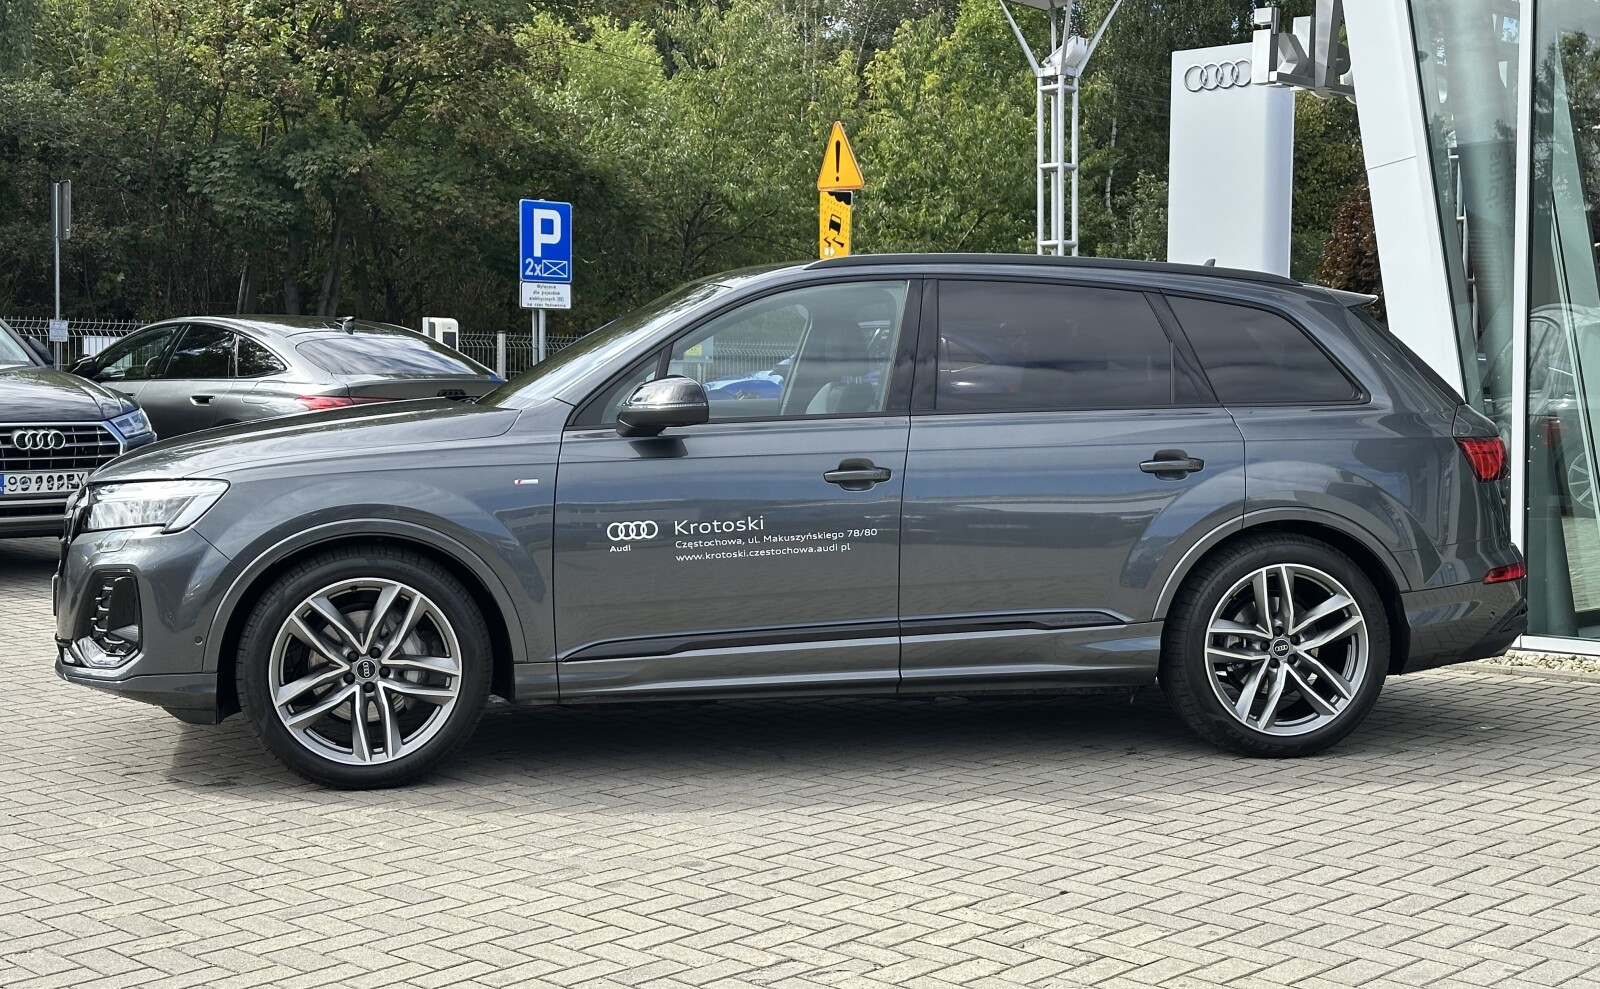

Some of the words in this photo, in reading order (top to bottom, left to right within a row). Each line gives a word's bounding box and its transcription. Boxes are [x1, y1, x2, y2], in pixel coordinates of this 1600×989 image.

[533, 208, 562, 258] P
[524, 258, 542, 276] 2x
[674, 515, 764, 536] Krotoski
[609, 544, 631, 553] Audi
[675, 537, 745, 550] Częstochowa,
[747, 536, 760, 545] ul.
[763, 531, 845, 543] Makuszyńskiego
[846, 527, 878, 538] 78/80
